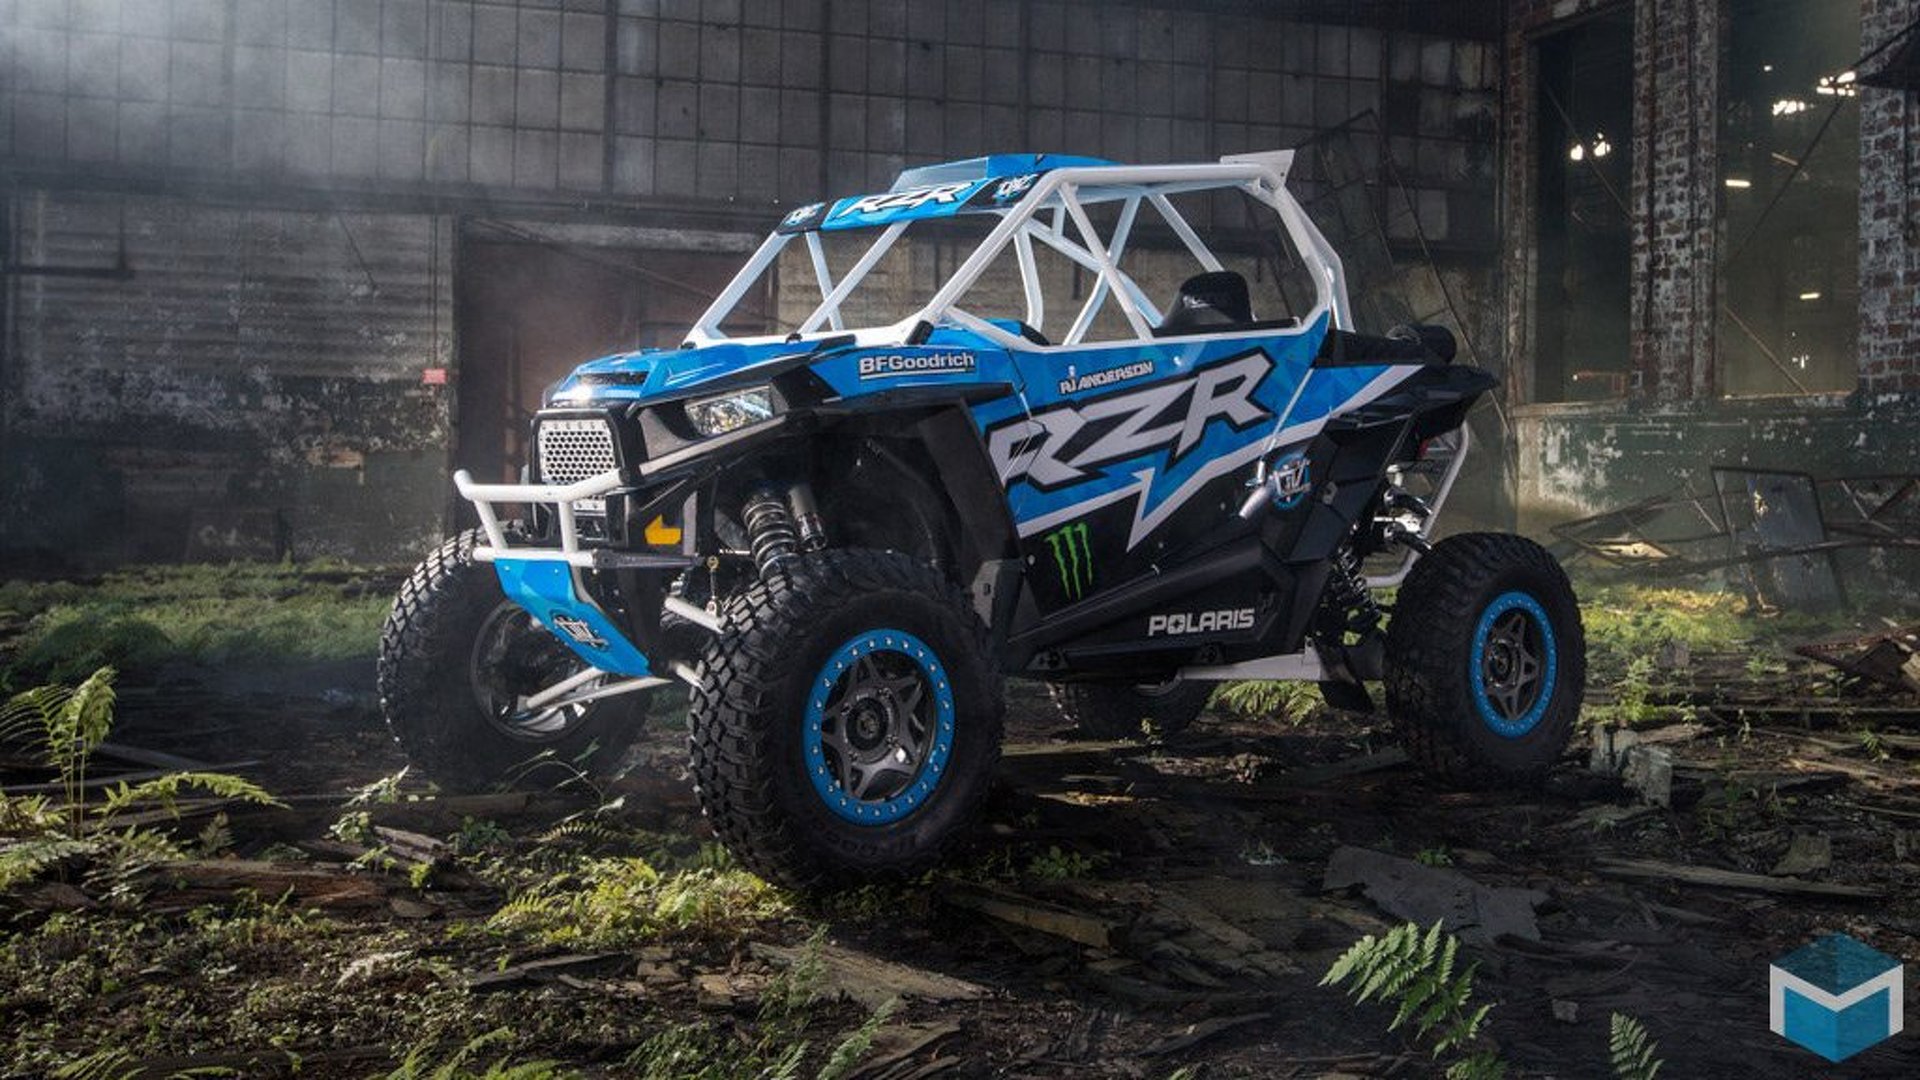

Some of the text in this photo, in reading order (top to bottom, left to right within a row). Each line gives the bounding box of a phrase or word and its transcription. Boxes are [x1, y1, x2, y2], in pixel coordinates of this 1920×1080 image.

[834, 181, 975, 217] RZR
[859, 352, 975, 375] BFGoodrich
[1078, 360, 1154, 391] ANDERSON
[986, 351, 1274, 490] RZR
[1148, 609, 1255, 637] POLARIS
